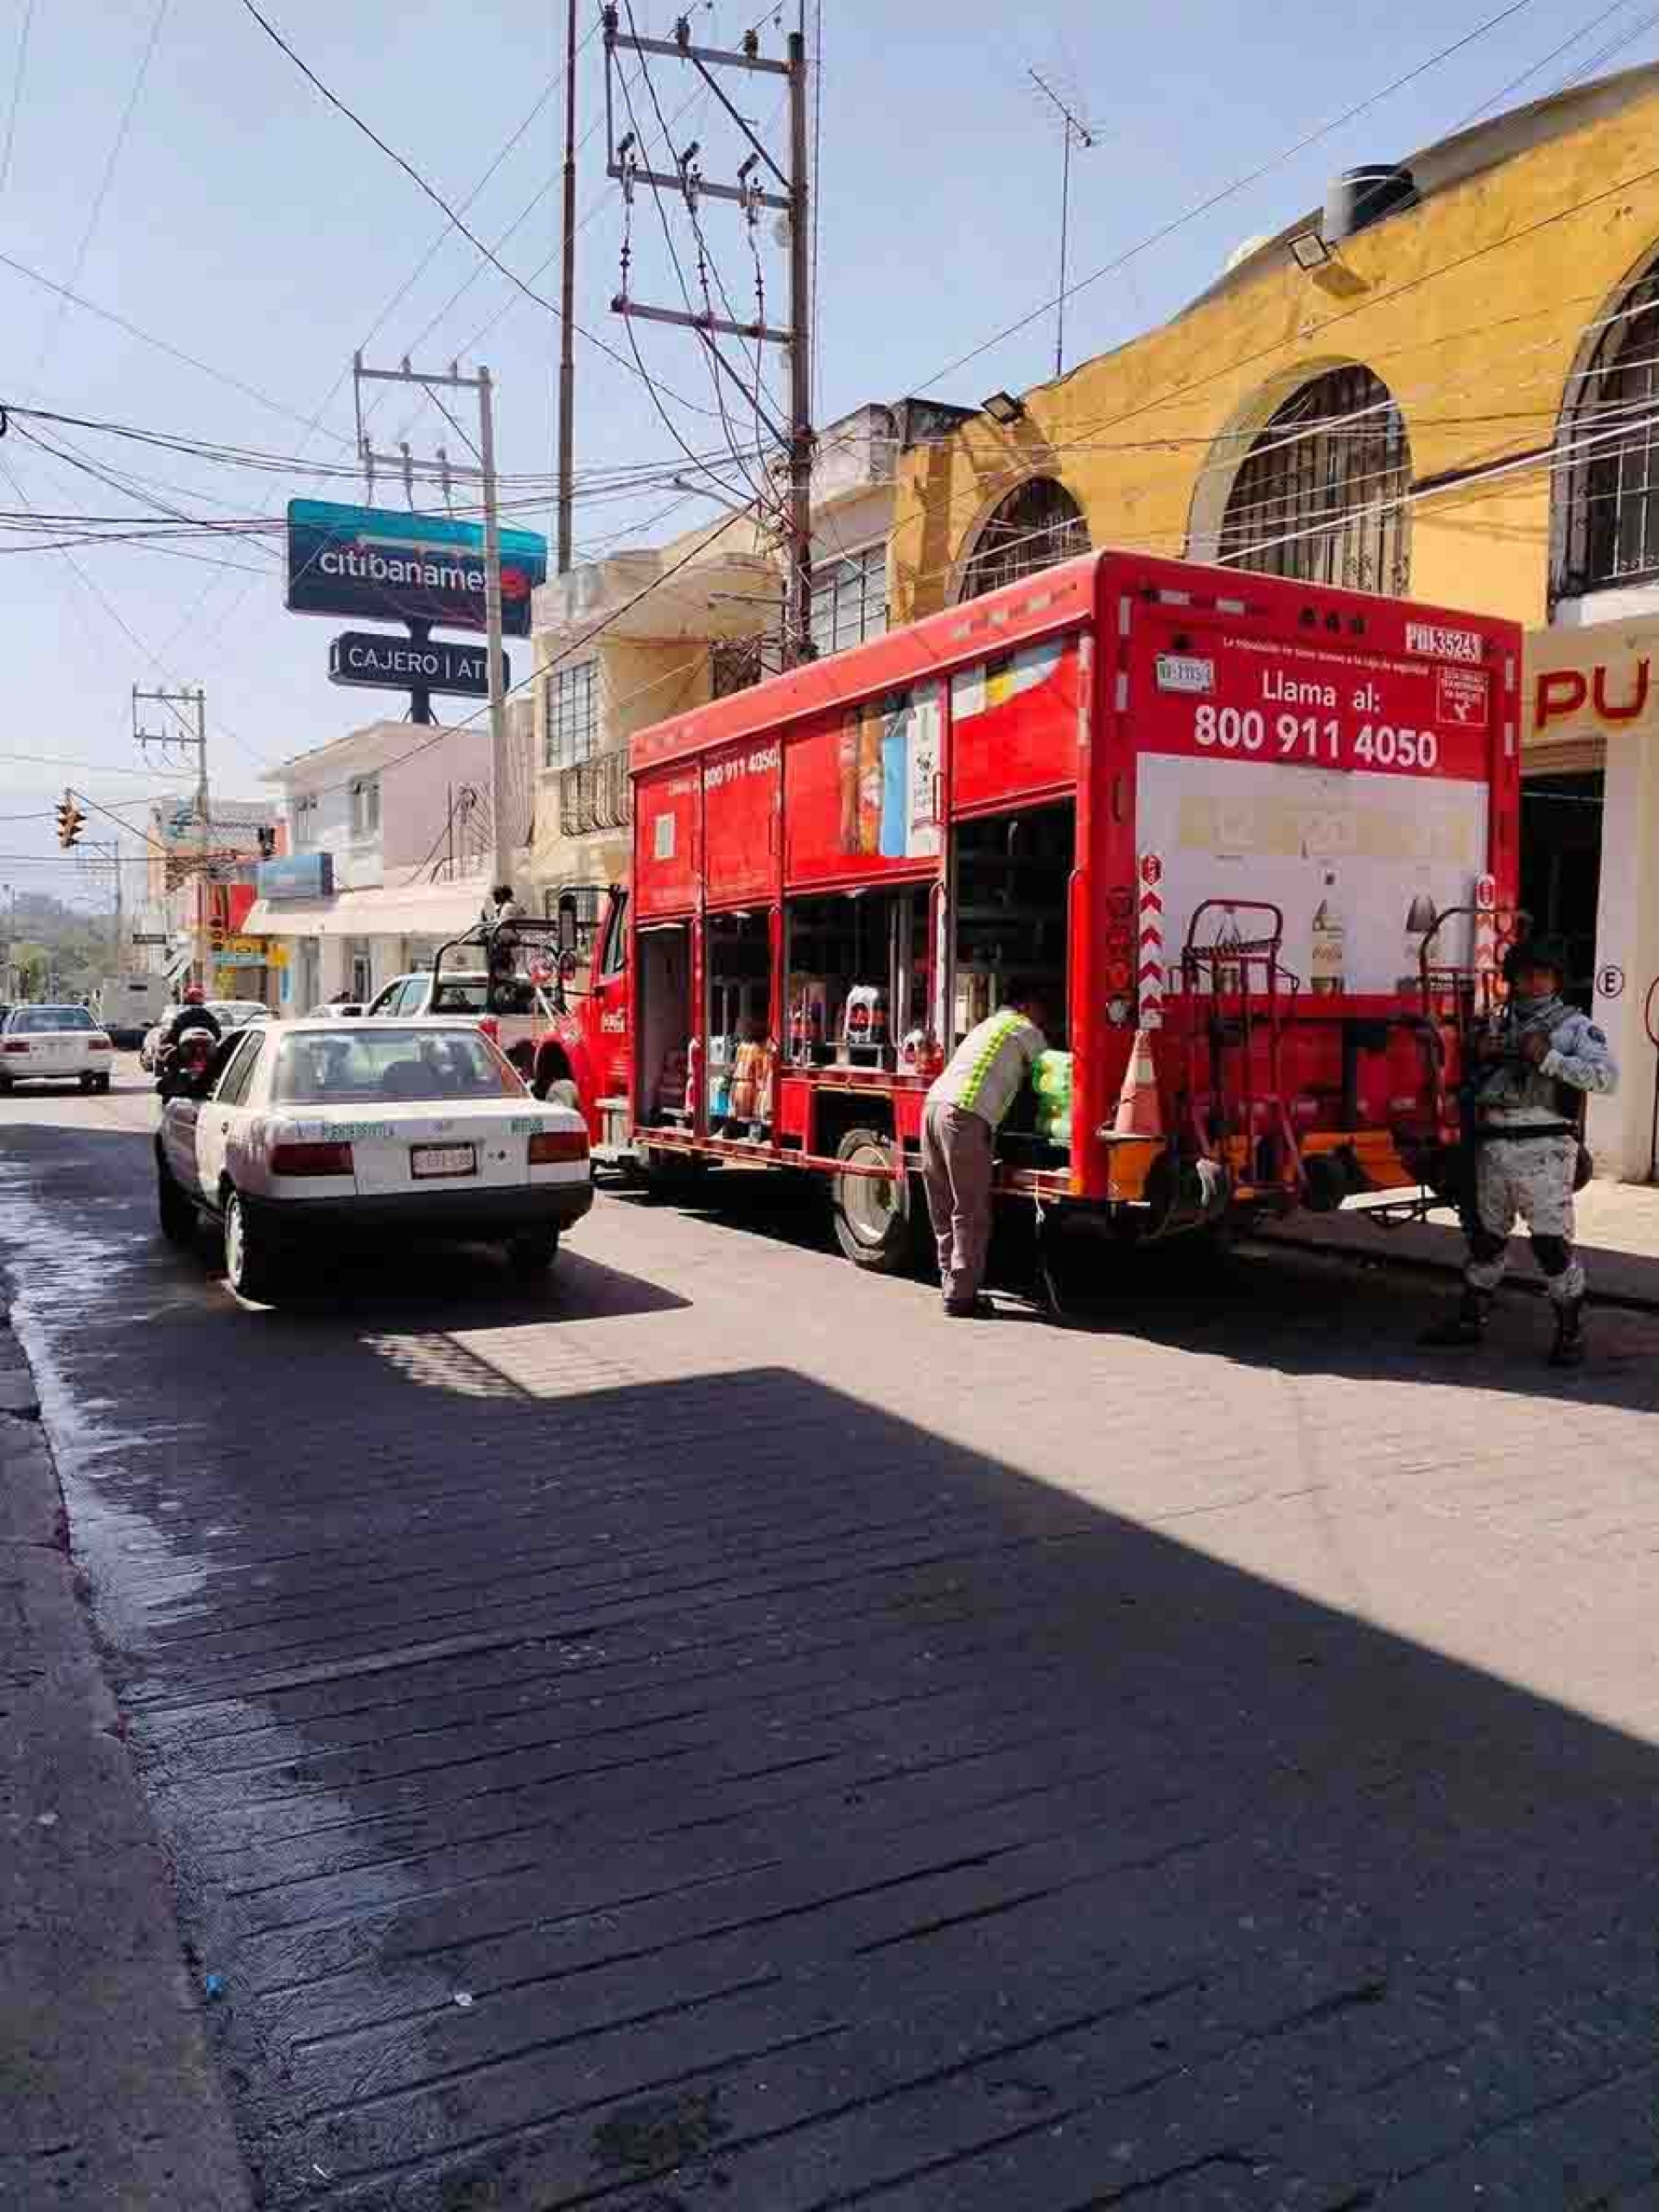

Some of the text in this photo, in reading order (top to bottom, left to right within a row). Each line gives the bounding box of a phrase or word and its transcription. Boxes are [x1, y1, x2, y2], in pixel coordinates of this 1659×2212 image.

[320, 550, 487, 592] citibaname
[347, 647, 487, 679] CAJERO AT
[1262, 669, 1381, 714] Llama al:
[1534, 658, 1650, 731] PU
[1194, 705, 1438, 768] 800 911 4050
